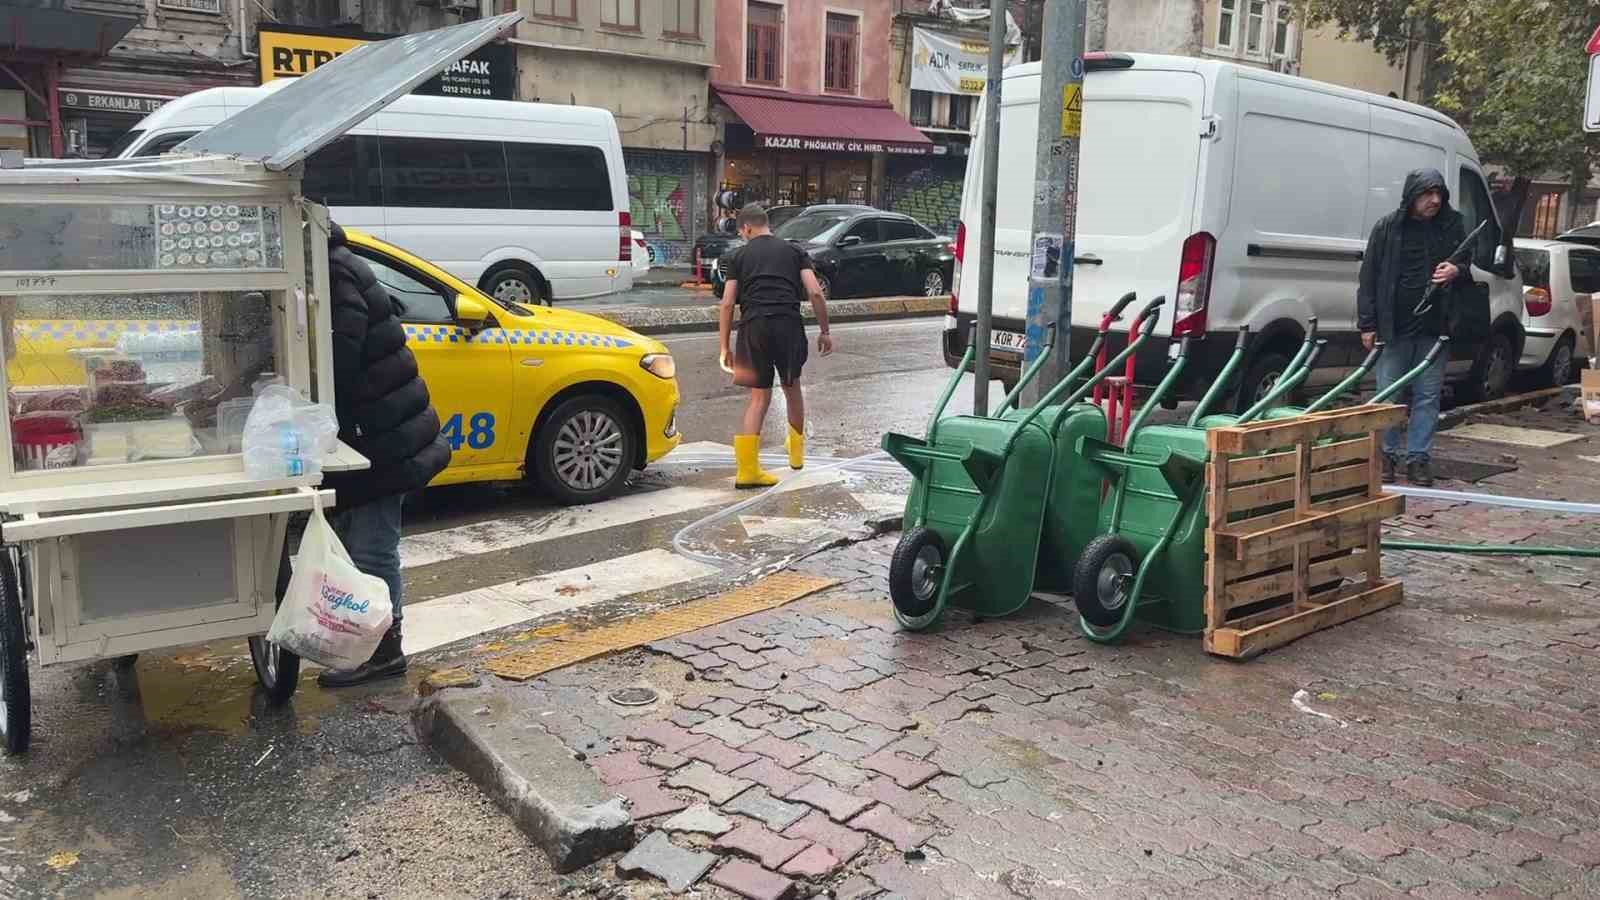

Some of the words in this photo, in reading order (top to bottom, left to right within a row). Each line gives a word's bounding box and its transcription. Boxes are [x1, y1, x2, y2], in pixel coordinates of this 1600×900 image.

[929, 51, 951, 70] ADA
[88, 95, 141, 110] ERKANLAR
[765, 136, 801, 149] KAZAR
[440, 412, 496, 451] 48
